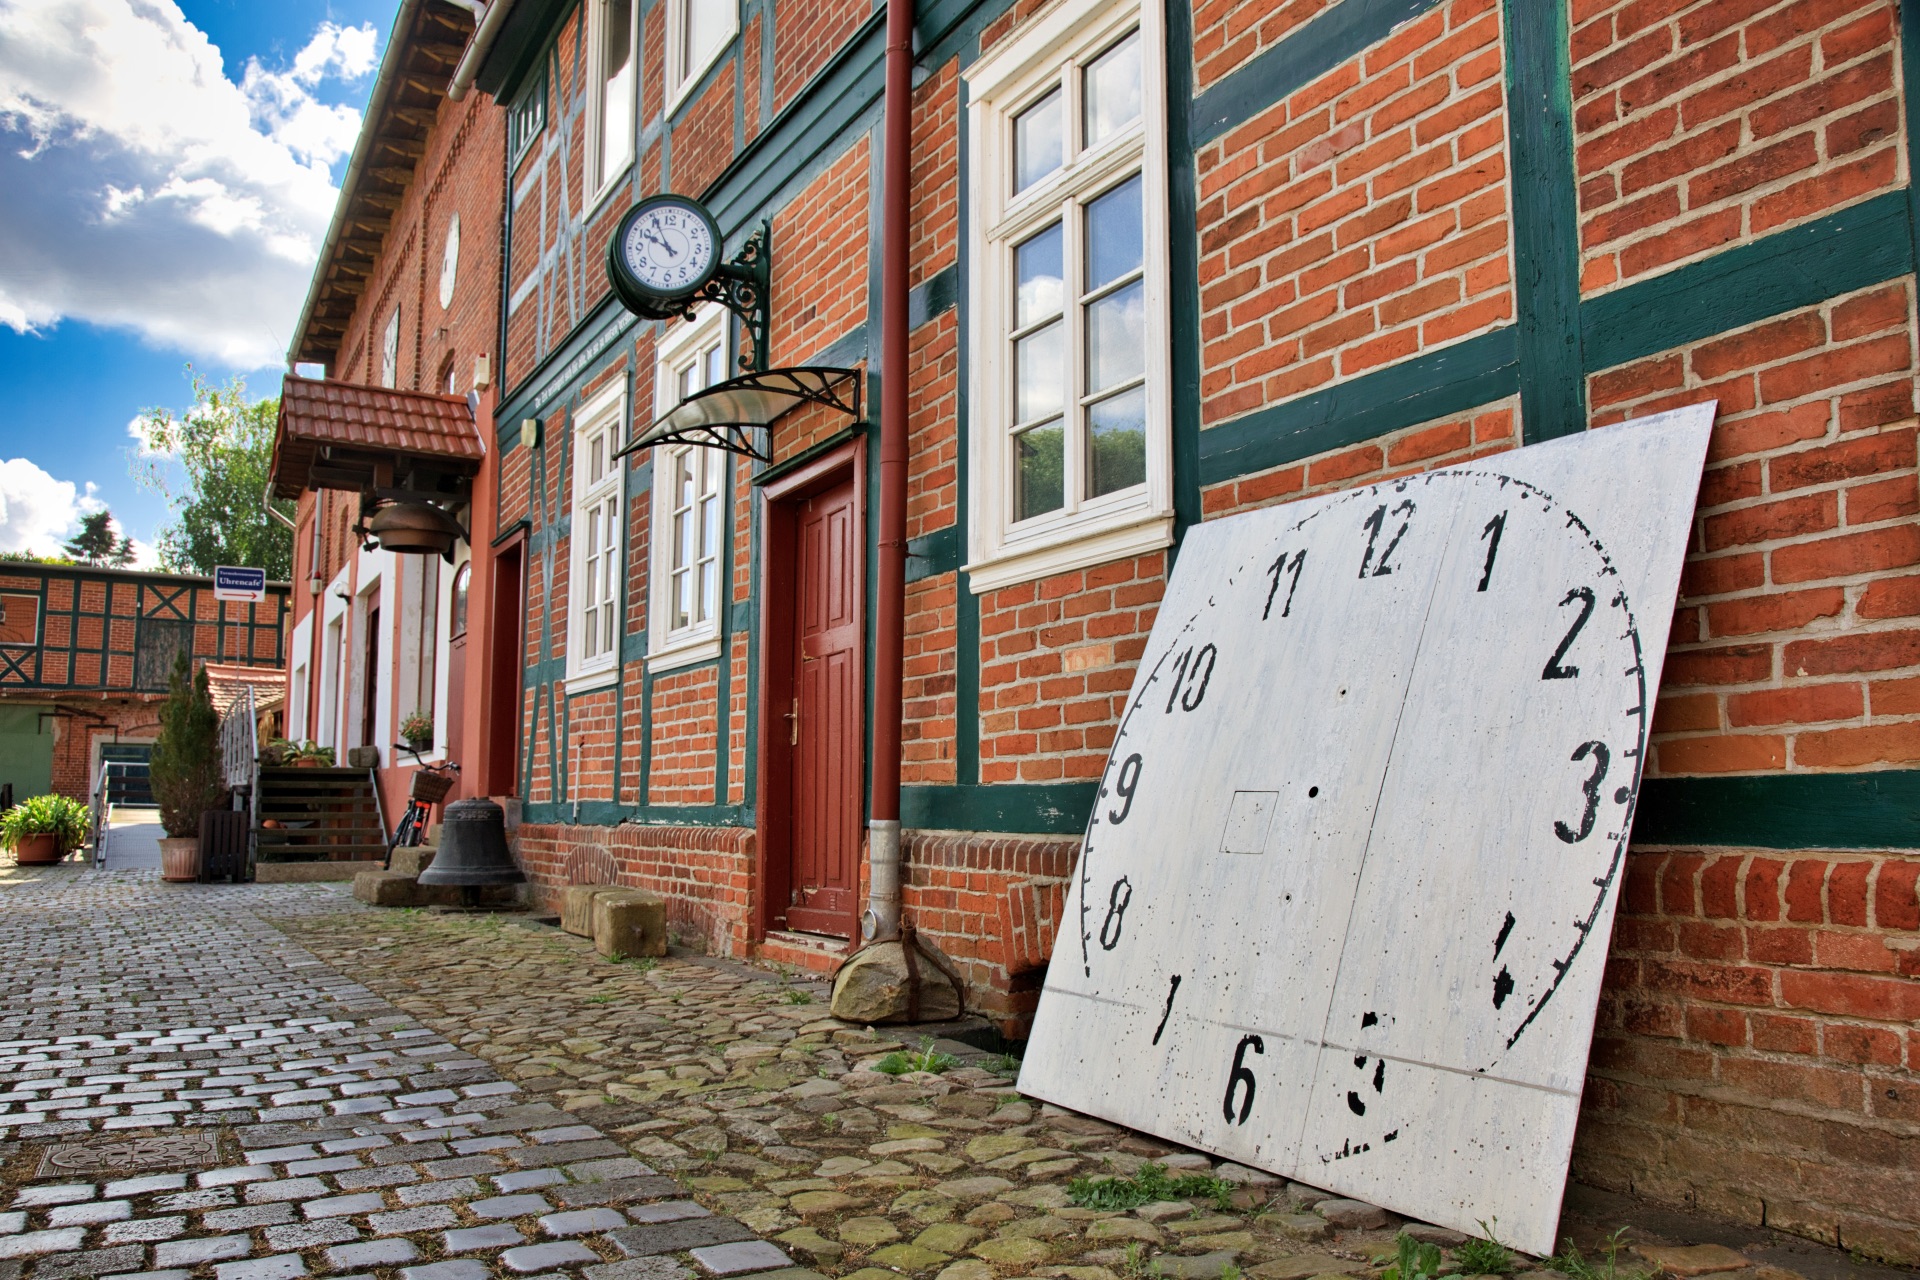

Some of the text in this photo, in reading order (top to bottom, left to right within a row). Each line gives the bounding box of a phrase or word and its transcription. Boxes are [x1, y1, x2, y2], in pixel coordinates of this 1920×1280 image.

[664, 214, 677, 226] 12
[682, 219, 687, 229] 1
[638, 228, 652, 240] 10
[690, 227, 699, 240] 2
[635, 241, 644, 255] 9
[694, 242, 703, 255] 3
[638, 256, 647, 269] 8
[689, 256, 699, 269] 4
[649, 266, 658, 278] 7
[663, 269, 672, 283] 6
[678, 266, 687, 279] 5
[1359, 498, 1416, 579] 12
[1477, 509, 1508, 593] 1
[1262, 548, 1309, 621] 11
[1541, 586, 1596, 681] 2
[1165, 642, 1218, 714] 10
[1108, 752, 1143, 825] 9
[1553, 740, 1612, 845] 3
[1099, 874, 1133, 951] 8
[1223, 1033, 1265, 1127] 6
